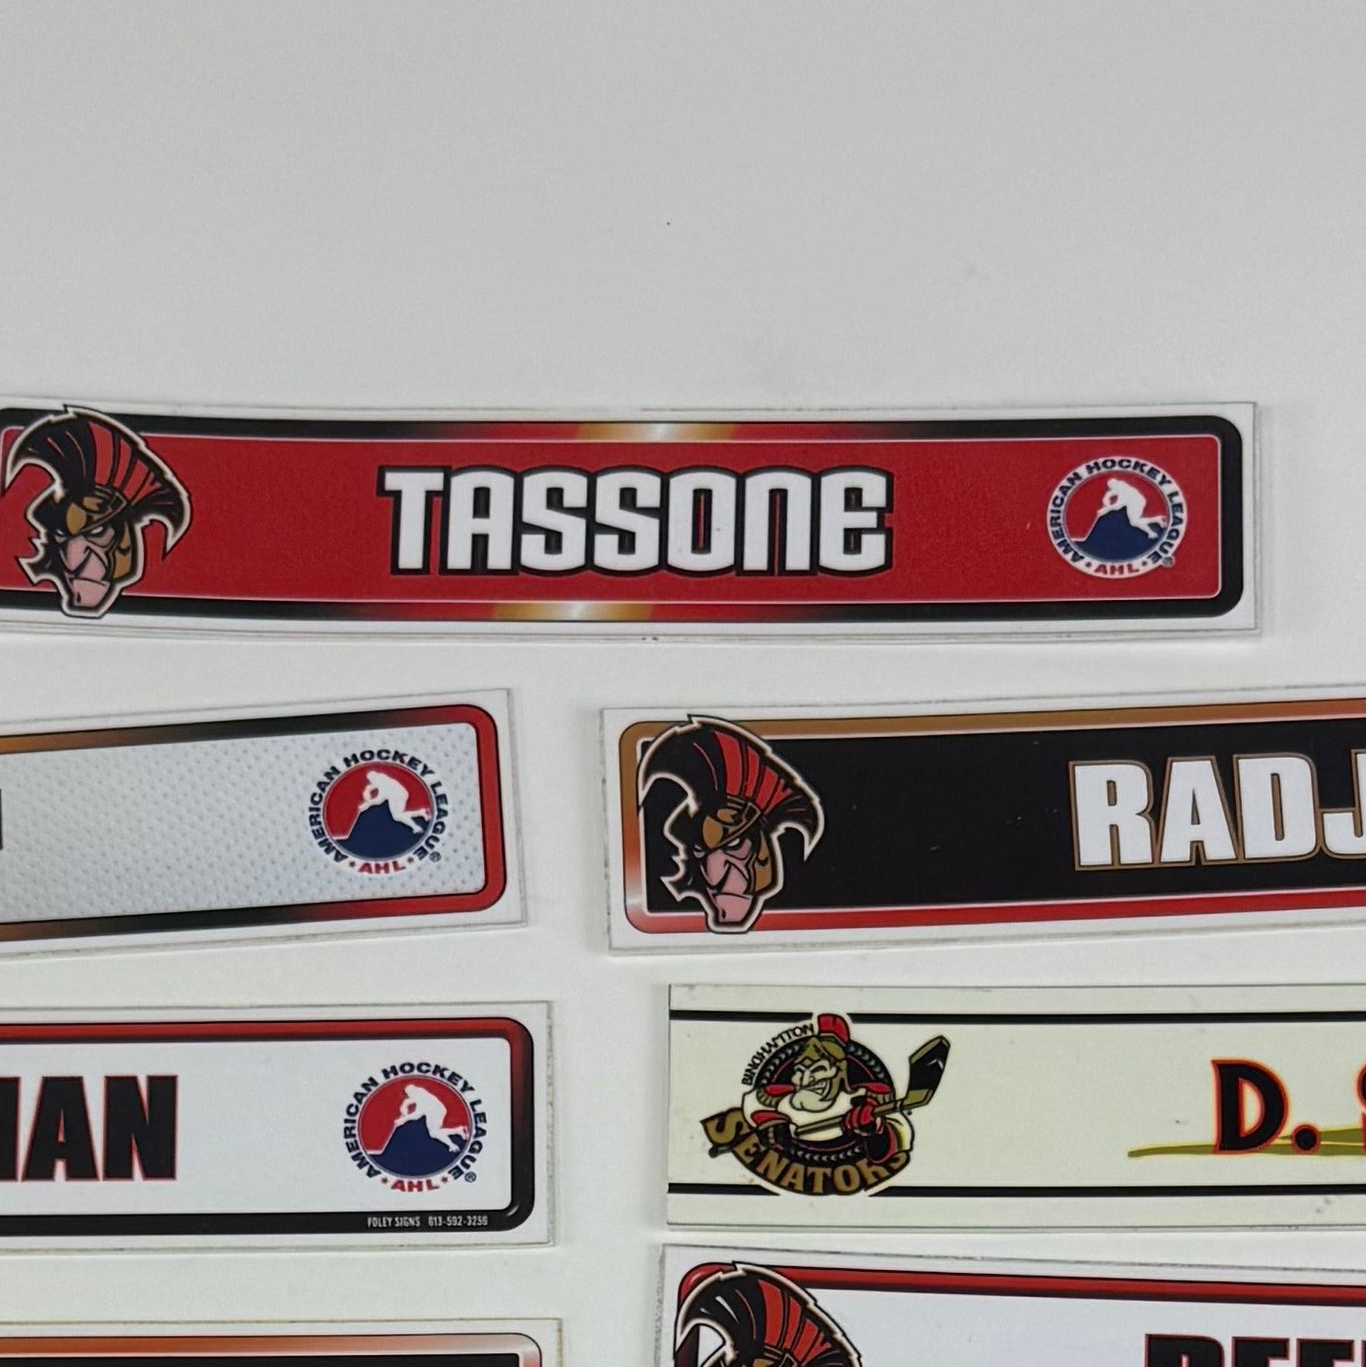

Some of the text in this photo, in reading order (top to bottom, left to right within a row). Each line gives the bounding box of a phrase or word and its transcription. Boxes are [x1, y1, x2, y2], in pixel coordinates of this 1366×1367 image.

[376, 464, 893, 577] TASSONE
[1050, 459, 1184, 564] AMERICAN HOCKEY LEAGUE
[1094, 563, 1139, 575] AHL
[309, 749, 449, 863] AMERICAN HOCKEY LEAGUE
[359, 860, 407, 874] AHL
[344, 1062, 487, 1180] AMERICAN HOCKEY LEAGUE
[1211, 1060, 1321, 1154] D.
[368, 1217, 392, 1228] FOLEY
[395, 1217, 421, 1227] SIGNS
[390, 1179, 440, 1192] AHL
